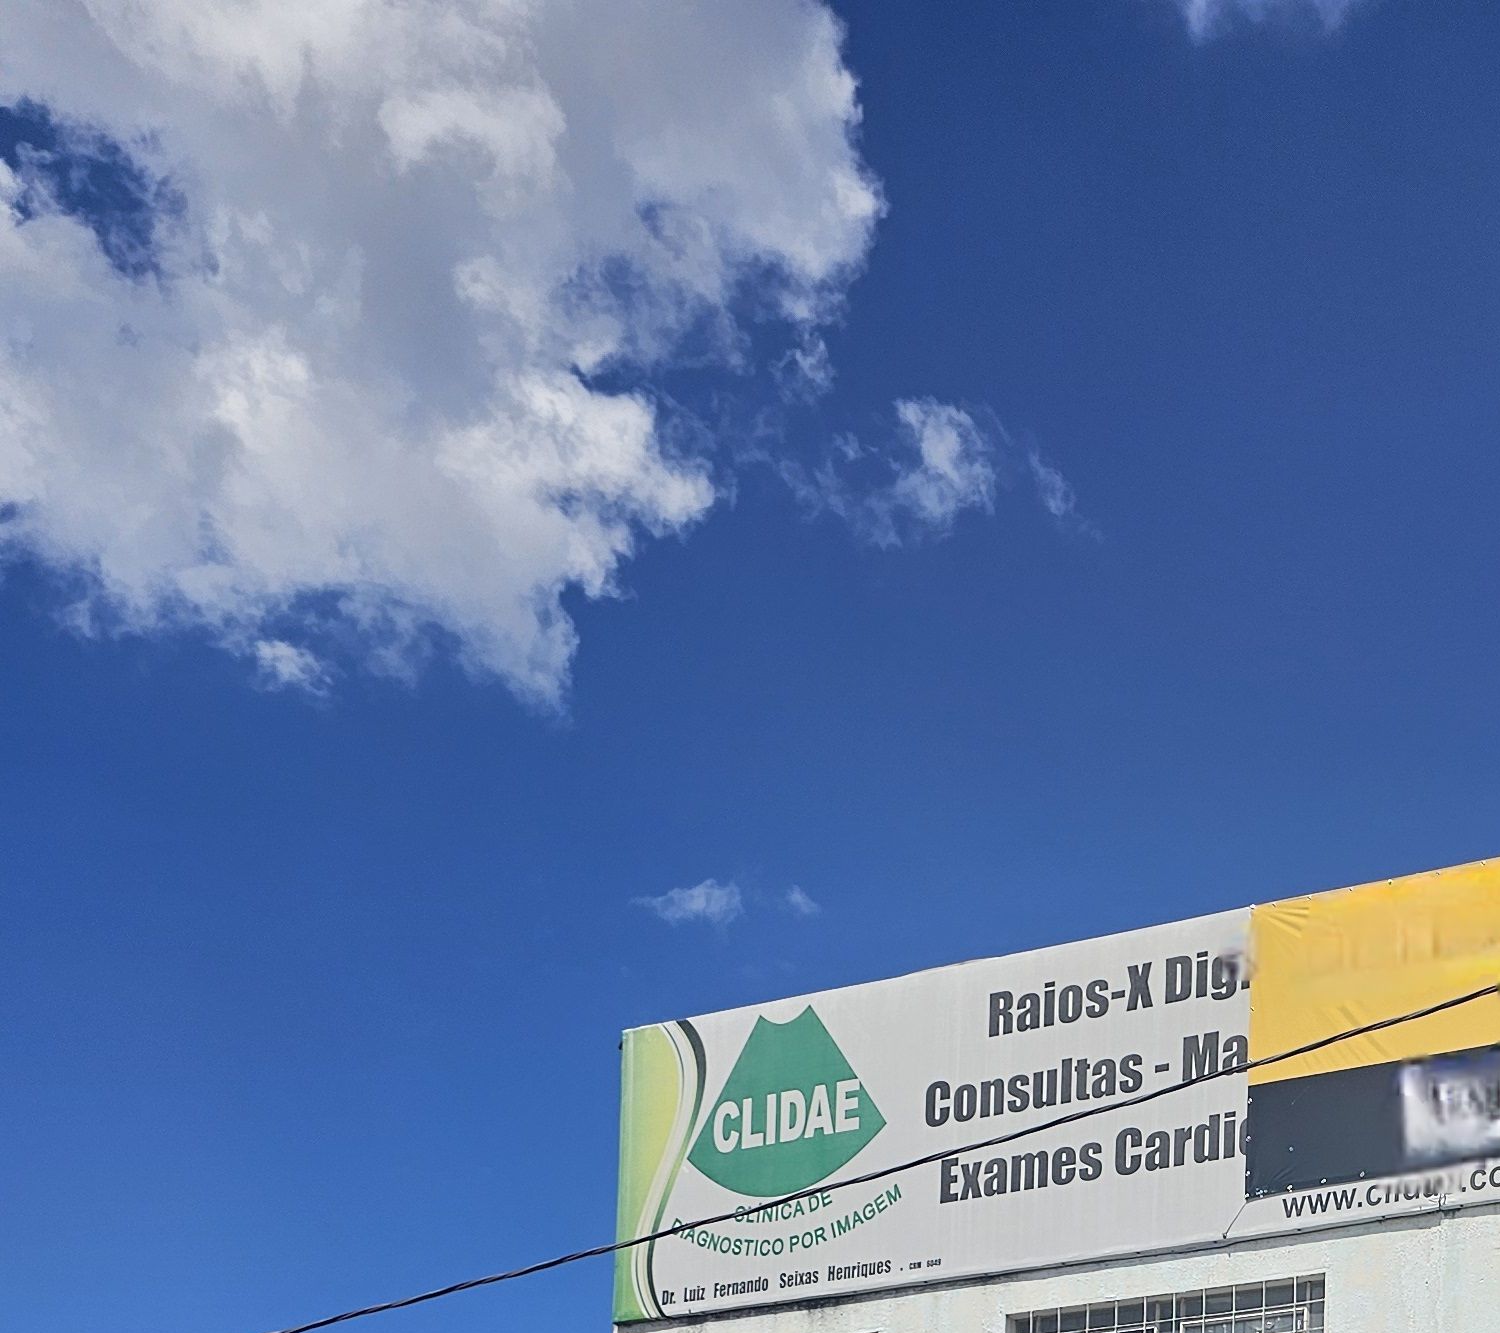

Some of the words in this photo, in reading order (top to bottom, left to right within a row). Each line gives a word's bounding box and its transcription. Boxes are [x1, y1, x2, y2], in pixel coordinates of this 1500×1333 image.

[988, 961, 1153, 1037] Raios-X
[1164, 950, 1250, 1003] Dig
[713, 1077, 861, 1154] CLIDAE
[924, 1053, 1144, 1127] Consultas
[808, 1190, 833, 1212] DE
[939, 1142, 1103, 1204] Exames
[790, 1227, 827, 1253] POR
[831, 1184, 903, 1239] IMAGEM
[661, 1289, 676, 1306] Dr.
[683, 1285, 705, 1303] Luiz
[713, 1276, 769, 1299] Fernando
[779, 1269, 819, 1289] Seixas
[827, 1259, 892, 1282] Henriques
